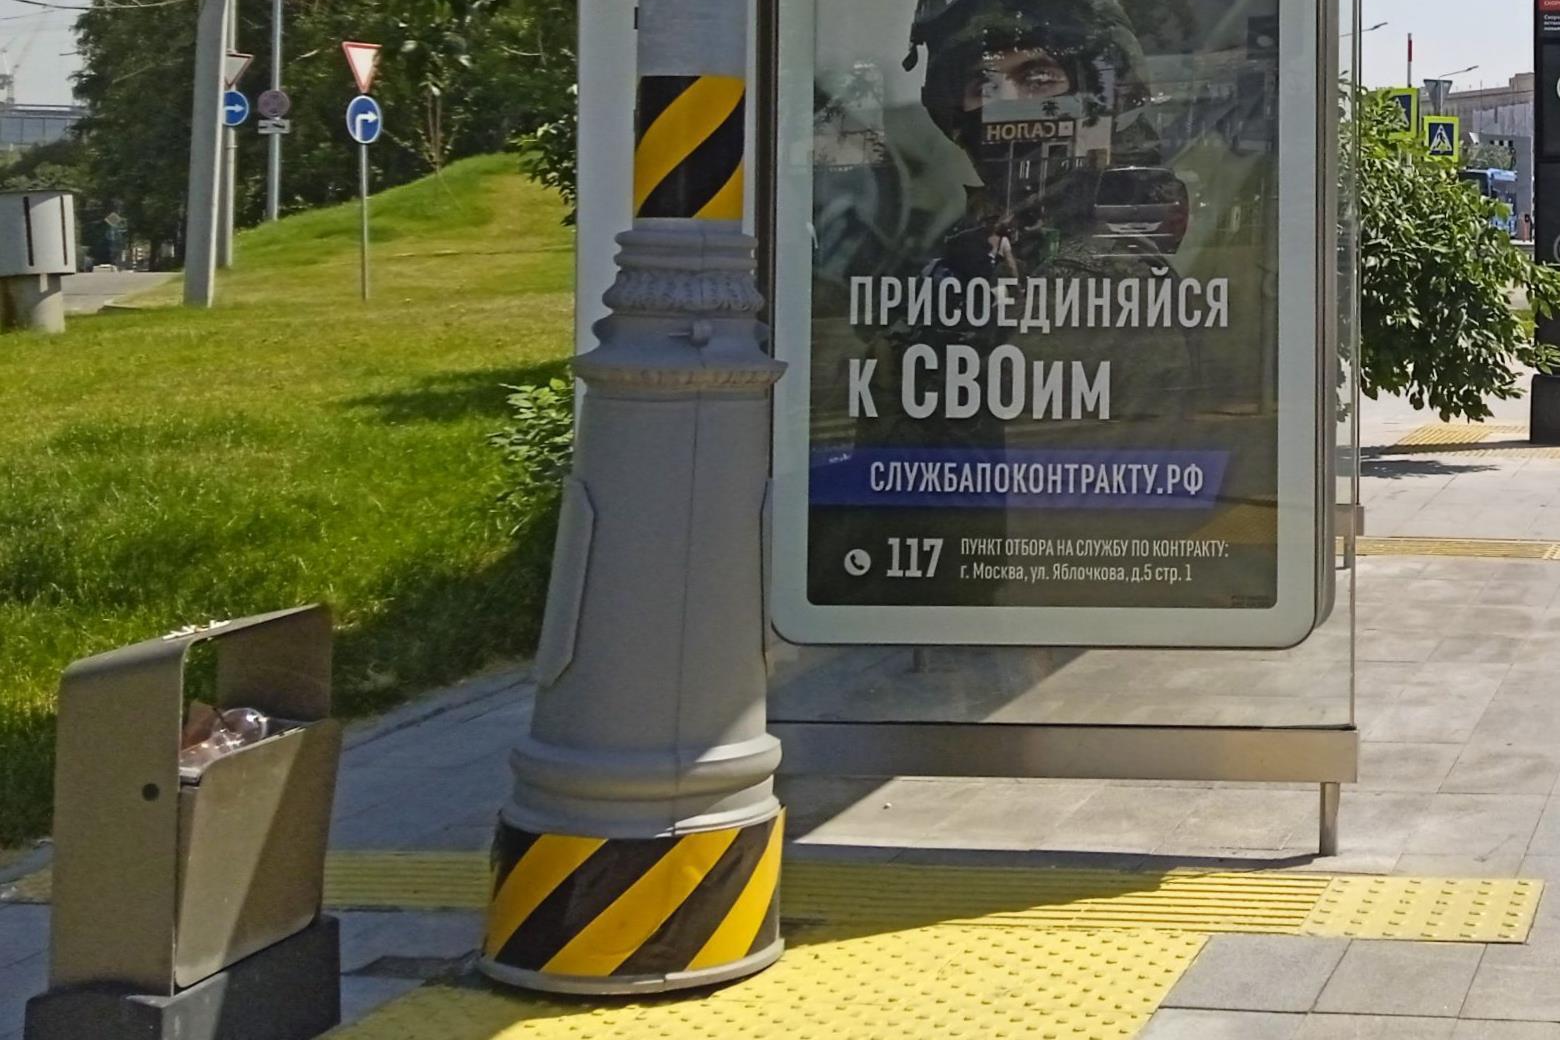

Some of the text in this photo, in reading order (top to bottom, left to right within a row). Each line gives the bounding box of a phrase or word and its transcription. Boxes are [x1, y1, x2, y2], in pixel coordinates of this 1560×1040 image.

[849, 266, 1229, 333] ПРИСОЕДИНЯЙСЯ
[869, 461, 1204, 496] СЛУЖБАПОКОНТРАКТУ.РФ
[885, 537, 944, 578] 117
[960, 539, 1230, 558] ПУНКТ ОТБОРА НА СЛУЖБУ ПО КОНТРАКТУ:
[960, 567, 970, 580] г.
[973, 563, 1027, 583] Москва,
[1030, 567, 1049, 585] ул.
[1052, 563, 1128, 583] Яблочкова,
[1155, 568, 1182, 586] стр.
[1184, 565, 1192, 581] 1
